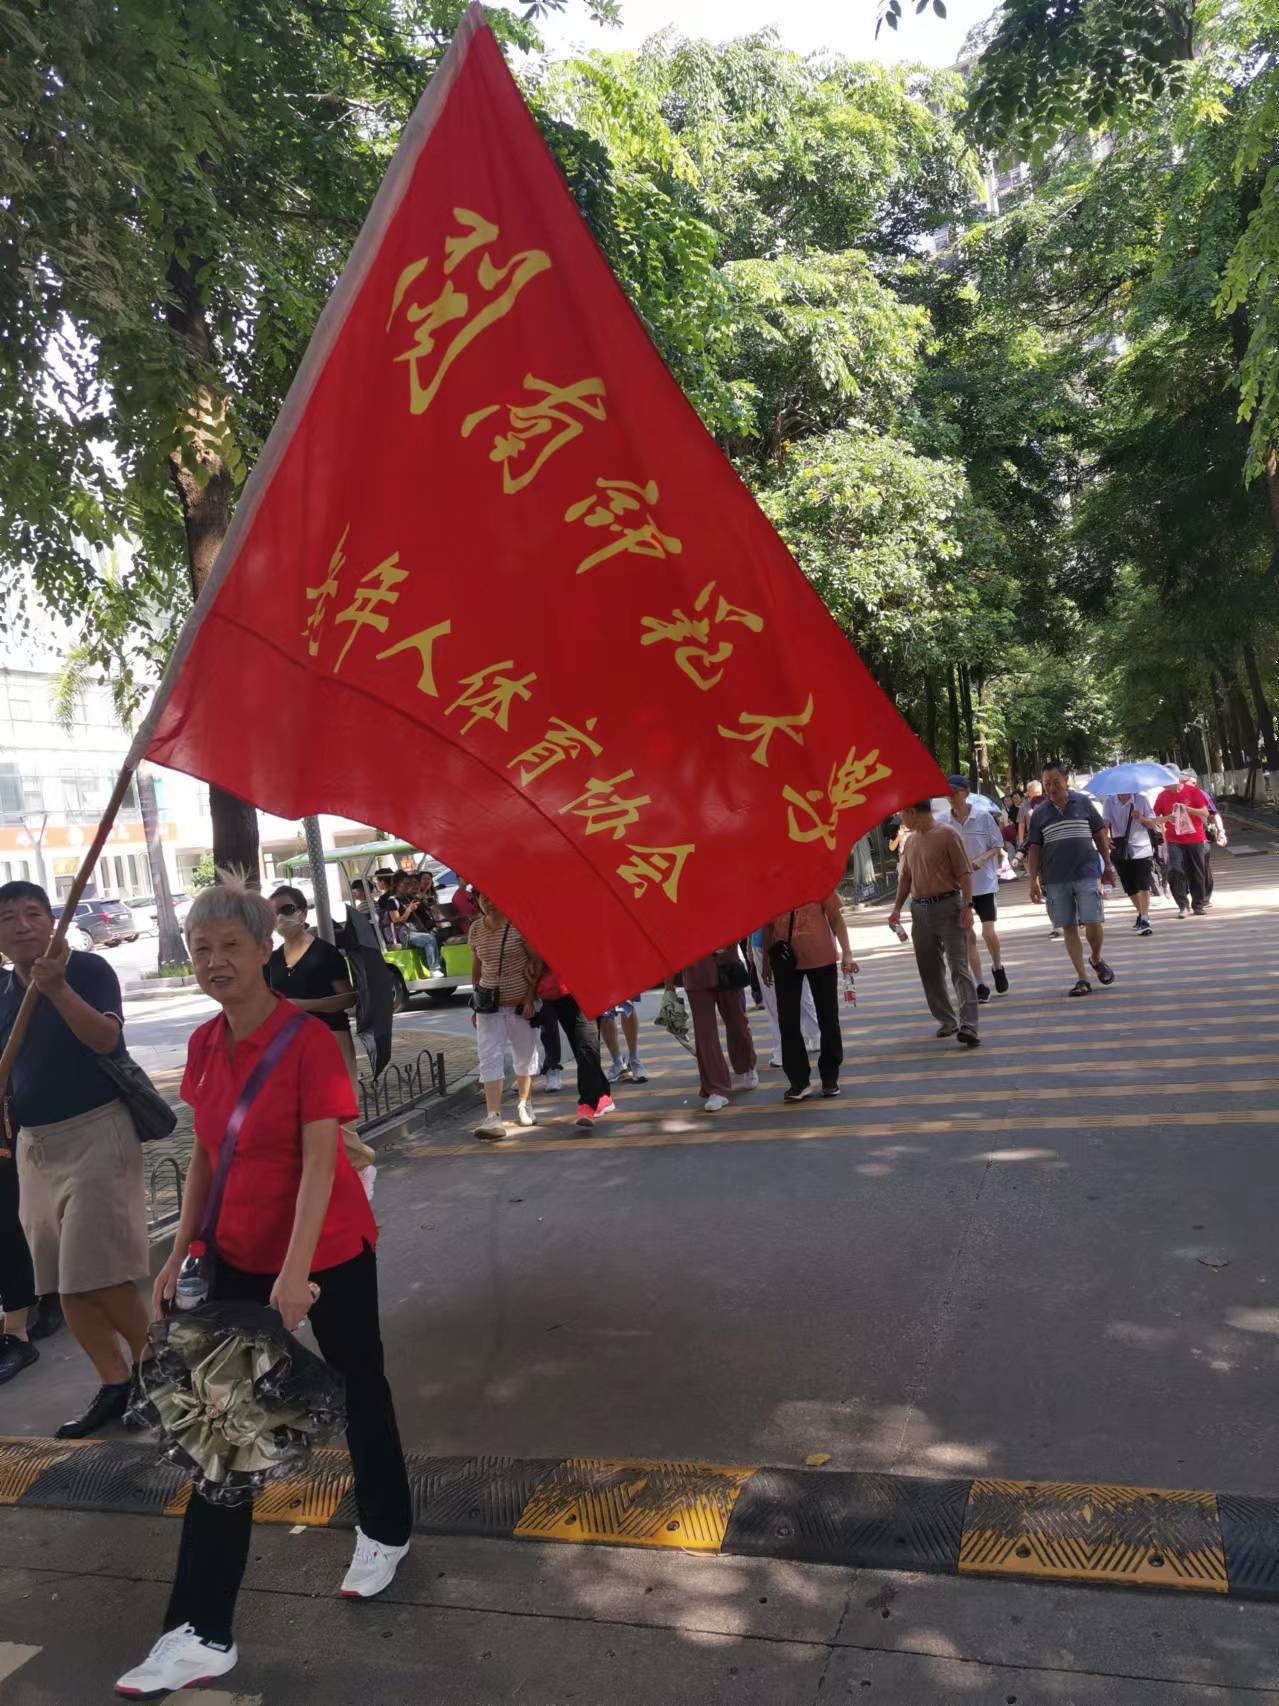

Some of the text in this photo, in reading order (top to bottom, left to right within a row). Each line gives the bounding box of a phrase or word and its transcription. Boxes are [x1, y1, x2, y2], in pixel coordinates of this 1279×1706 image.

[303, 523, 695, 901] 老年人体育协会
